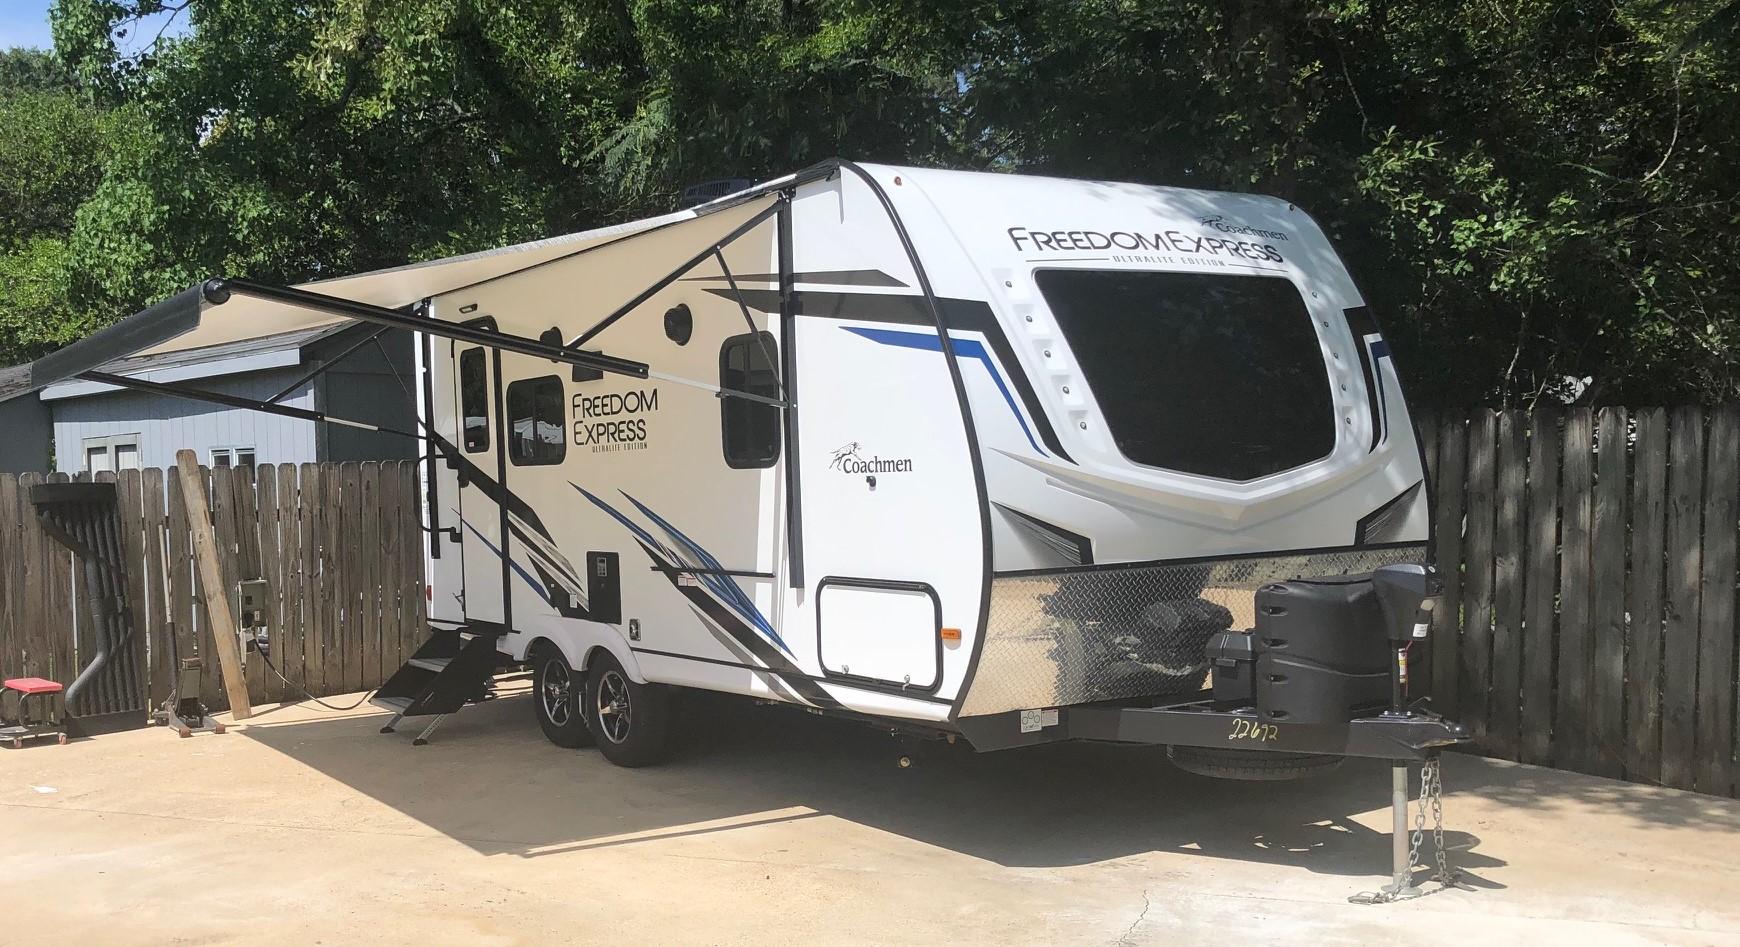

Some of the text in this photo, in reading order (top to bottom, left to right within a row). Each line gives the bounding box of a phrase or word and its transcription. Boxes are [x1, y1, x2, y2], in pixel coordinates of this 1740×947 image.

[1215, 223, 1288, 240] Coachmen
[1112, 255, 1225, 266] ULTRALITE EDITION
[572, 388, 658, 418] FREEDOM
[573, 419, 647, 446] EXPRESS
[843, 456, 912, 473] Coachmen
